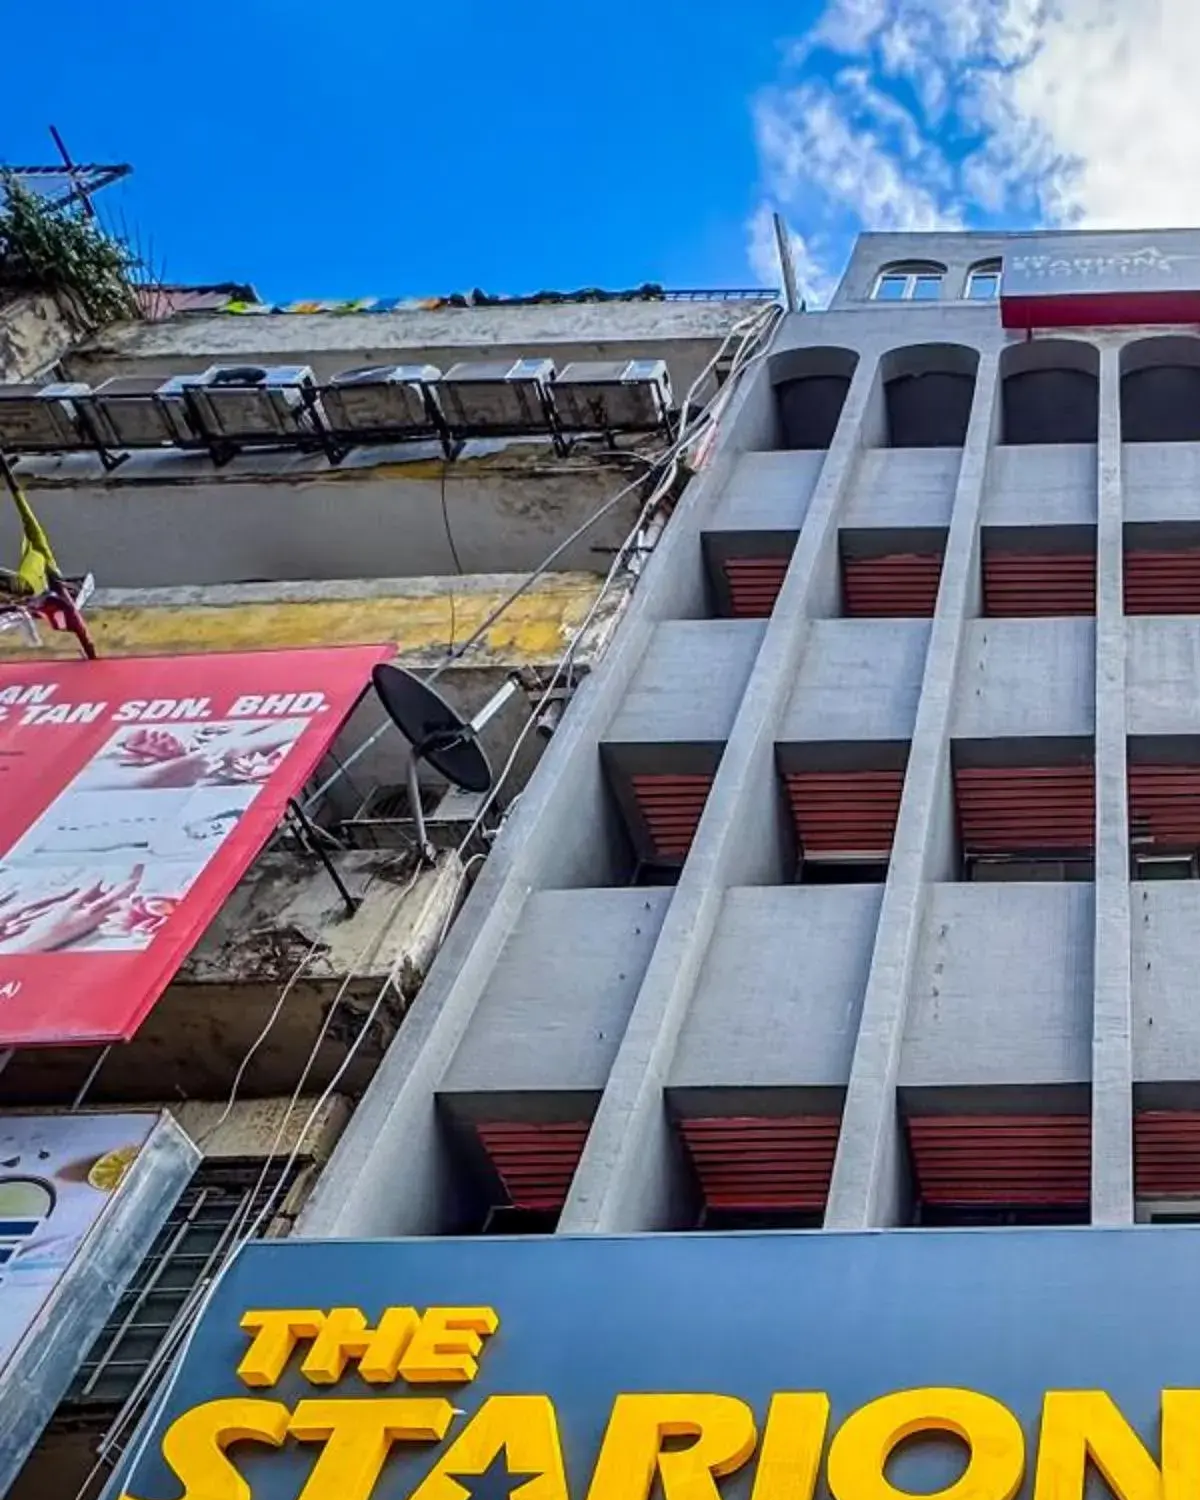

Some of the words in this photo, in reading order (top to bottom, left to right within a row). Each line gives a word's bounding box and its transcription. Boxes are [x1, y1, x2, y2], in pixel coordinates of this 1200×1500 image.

[18, 702, 109, 726] TAN
[112, 697, 212, 722] SDN.
[226, 691, 331, 717] BHD.
[237, 1305, 499, 1387] THE
